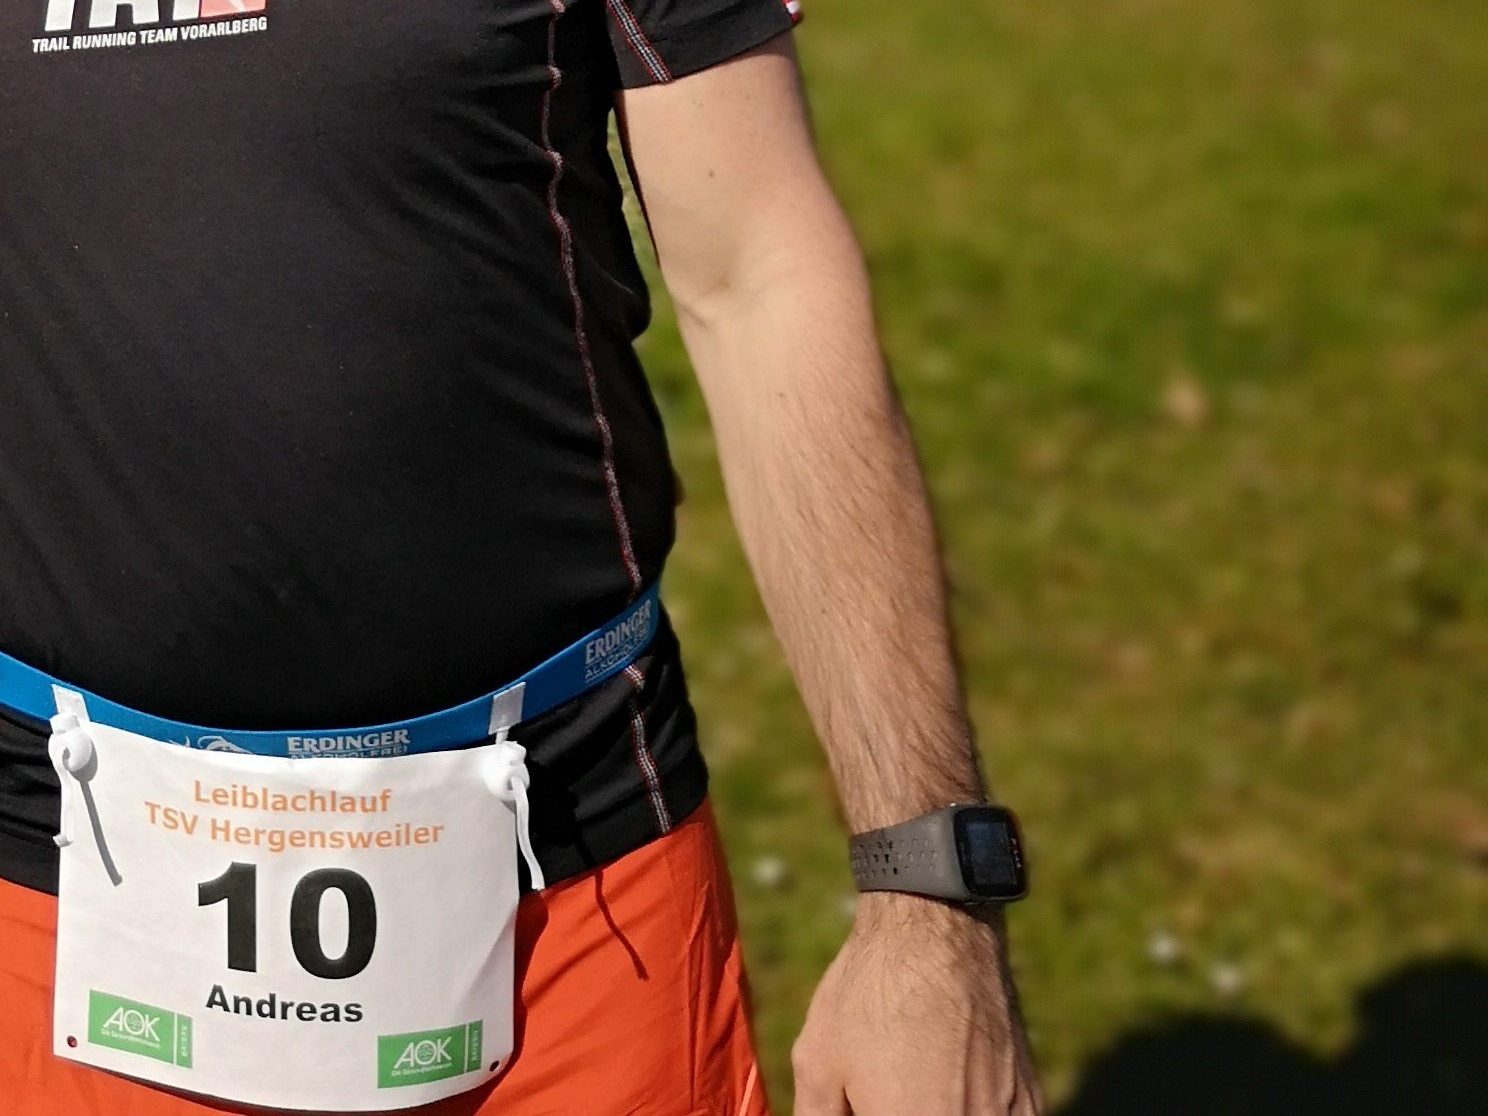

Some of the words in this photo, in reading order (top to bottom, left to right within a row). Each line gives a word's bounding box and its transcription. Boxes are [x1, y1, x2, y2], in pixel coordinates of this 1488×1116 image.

[32, 36, 70, 53] TRAIL
[72, 30, 136, 51] RUNNING
[140, 27, 178, 45] TEAM
[181, 16, 267, 41] VORARLBERG
[287, 729, 411, 753] ERDINGER
[194, 779, 391, 814] Leiblachlauf
[144, 801, 198, 835] TSV
[210, 819, 444, 853] Hergensweiler
[197, 862, 378, 980] 10
[205, 984, 364, 1024] Andreas
[102, 1006, 161, 1042] AOK
[392, 1035, 453, 1069] AOK
